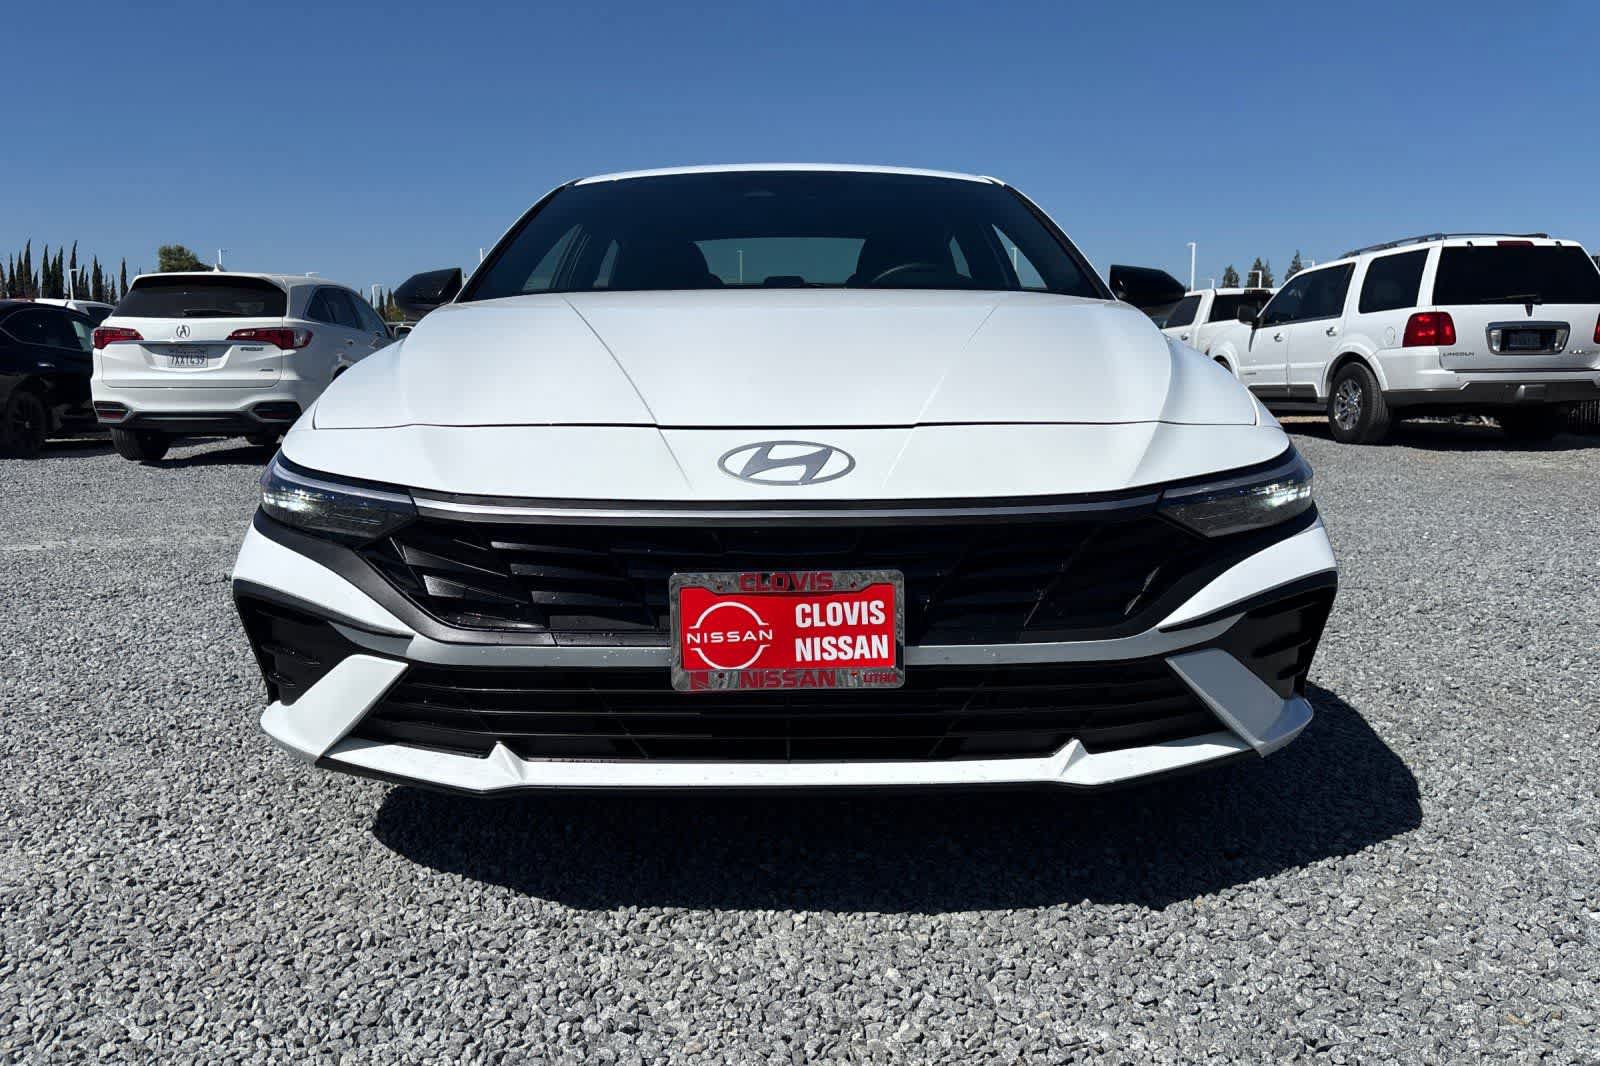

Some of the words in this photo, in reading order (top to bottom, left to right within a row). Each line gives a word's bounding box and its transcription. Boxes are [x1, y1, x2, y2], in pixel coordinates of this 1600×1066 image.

[740, 572, 833, 592] CLOVIS
[795, 600, 886, 628] CLOVIS
[687, 630, 773, 645] NISSAN
[795, 634, 889, 662] NISSAN
[740, 671, 836, 688] NISSAN
